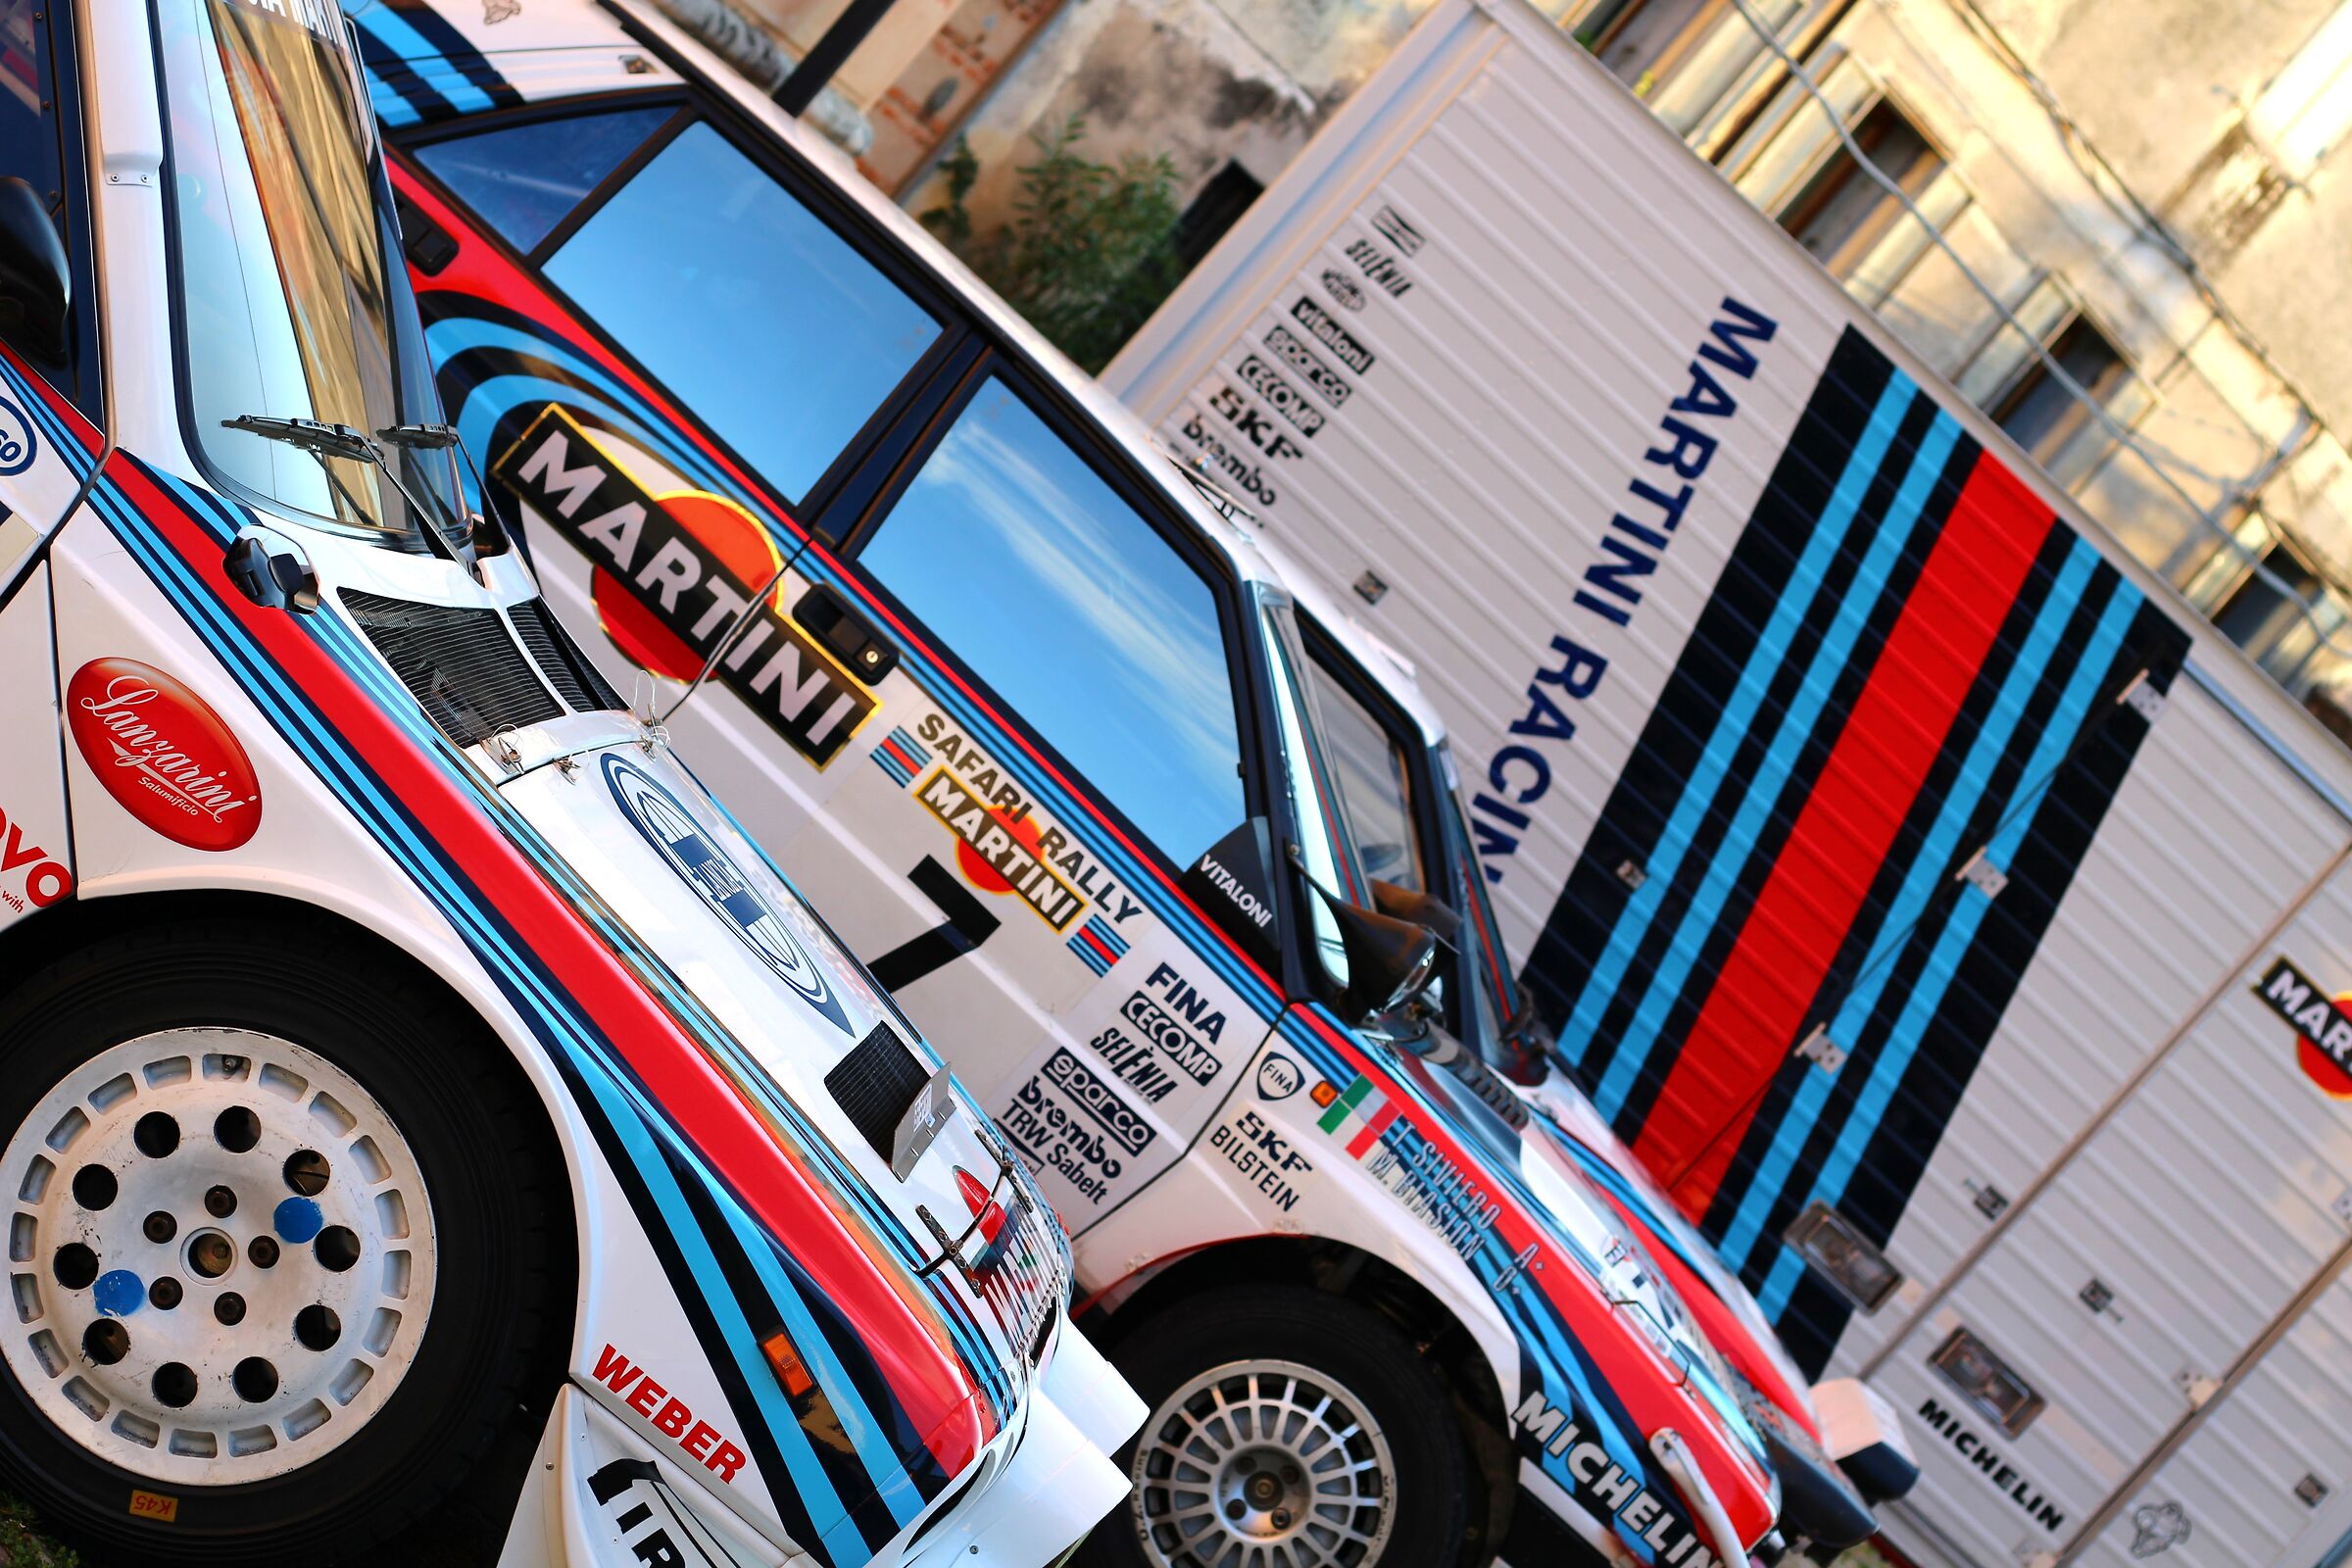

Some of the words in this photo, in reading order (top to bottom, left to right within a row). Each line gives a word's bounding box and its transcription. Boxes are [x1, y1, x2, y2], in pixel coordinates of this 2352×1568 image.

[1295, 300, 1372, 375] vitaloni
[1209, 386, 1303, 460] SKF
[1239, 356, 1323, 435] CECOMP
[1182, 413, 1277, 507] brembo
[1572, 294, 1779, 627] MARTINI
[517, 429, 857, 747] MARTINI
[80, 674, 258, 824] Lanzarini
[137, 775, 199, 816] Salumificio
[1471, 633, 1610, 884] RACIN
[917, 713, 1033, 823] SAFARI
[1035, 827, 1143, 924] RALLY
[924, 776, 1079, 927] MARTINI
[2, 890, 24, 913] with
[866, 854, 1002, 994] 7
[1198, 854, 1273, 929] VITALONI
[1126, 996, 1220, 1080] CECOMP
[1145, 961, 1227, 1046] FINA
[2267, 969, 2352, 1067] MAR
[1049, 1054, 1150, 1149] sparco
[1263, 1063, 1293, 1093] FINA
[1002, 1098, 1054, 1150] TRW
[1047, 1143, 1108, 1205] Sabelt
[1017, 1075, 1122, 1179] brembo
[1210, 1124, 1300, 1212] BILSTEIN
[1236, 1110, 1313, 1172] SKF
[1392, 1169, 1487, 1262] BIASION
[1411, 1141, 1502, 1232] SIVIERO
[592, 1343, 747, 1485] WEBER
[133, 1494, 172, 1515] K45
[1918, 1397, 2065, 1533] MICHELIN
